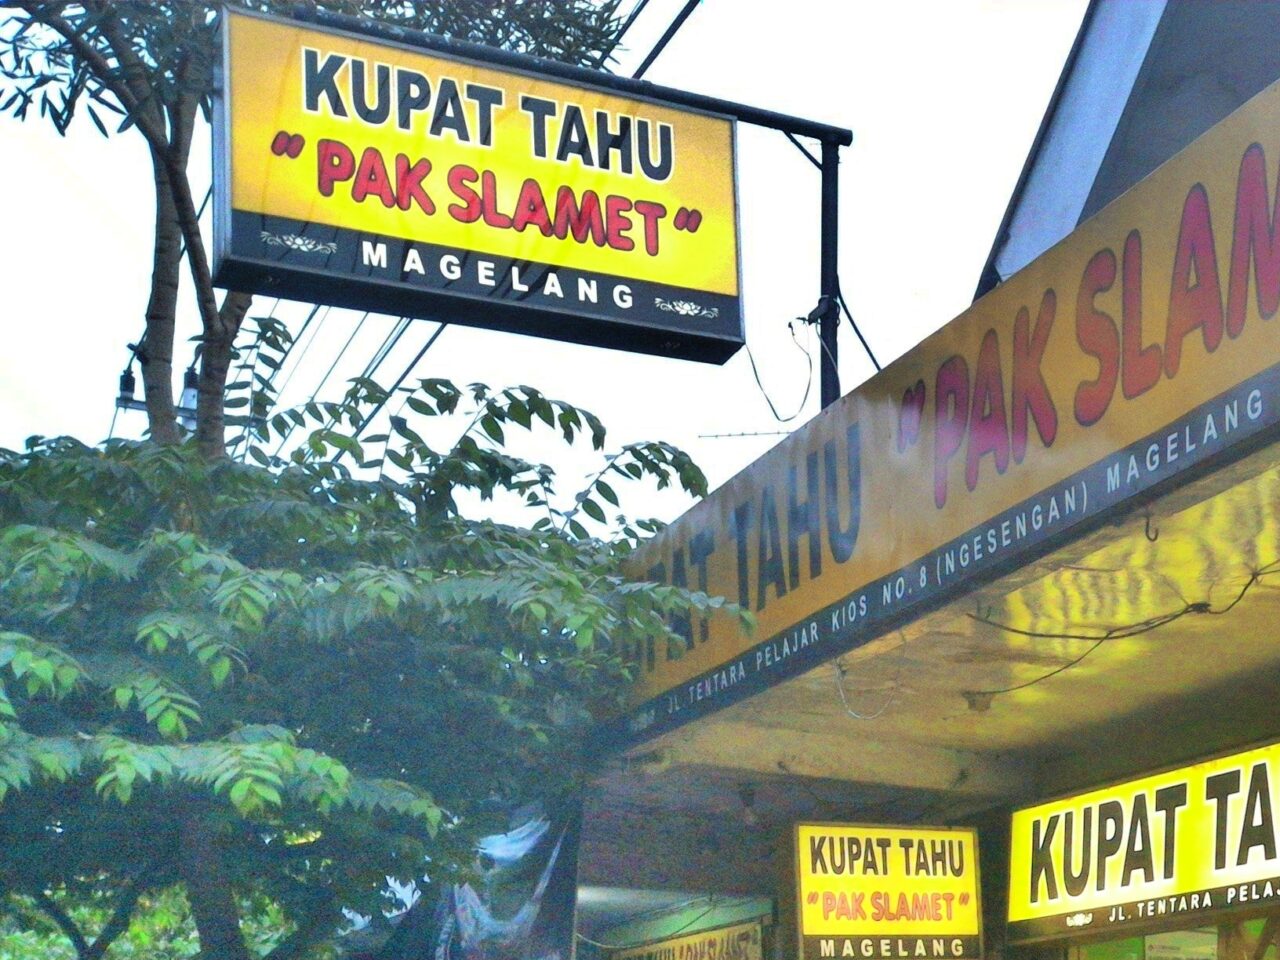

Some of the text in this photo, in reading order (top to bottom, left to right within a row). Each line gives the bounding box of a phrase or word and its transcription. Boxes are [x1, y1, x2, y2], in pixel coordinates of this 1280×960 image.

[302, 48, 673, 180] KUPAT TAHU
[362, 243, 633, 309] MAGELANG
[689, 661, 746, 703] TENTARA
[756, 621, 819, 668] PELAJAR
[831, 595, 867, 633] KIOS
[882, 575, 913, 606] NO.
[919, 565, 928, 589] 8
[936, 480, 1088, 586] (NGESENGAN)
[1106, 389, 1263, 493] MAGELANG
[729, 423, 862, 622] TAHU
[810, 836, 964, 878] KUPAT TAHU
[1029, 782, 1187, 904] KUPAT
[820, 938, 965, 957] MAGELANG
[1108, 902, 1131, 923] JL.
[1137, 891, 1213, 918] TENTARA
